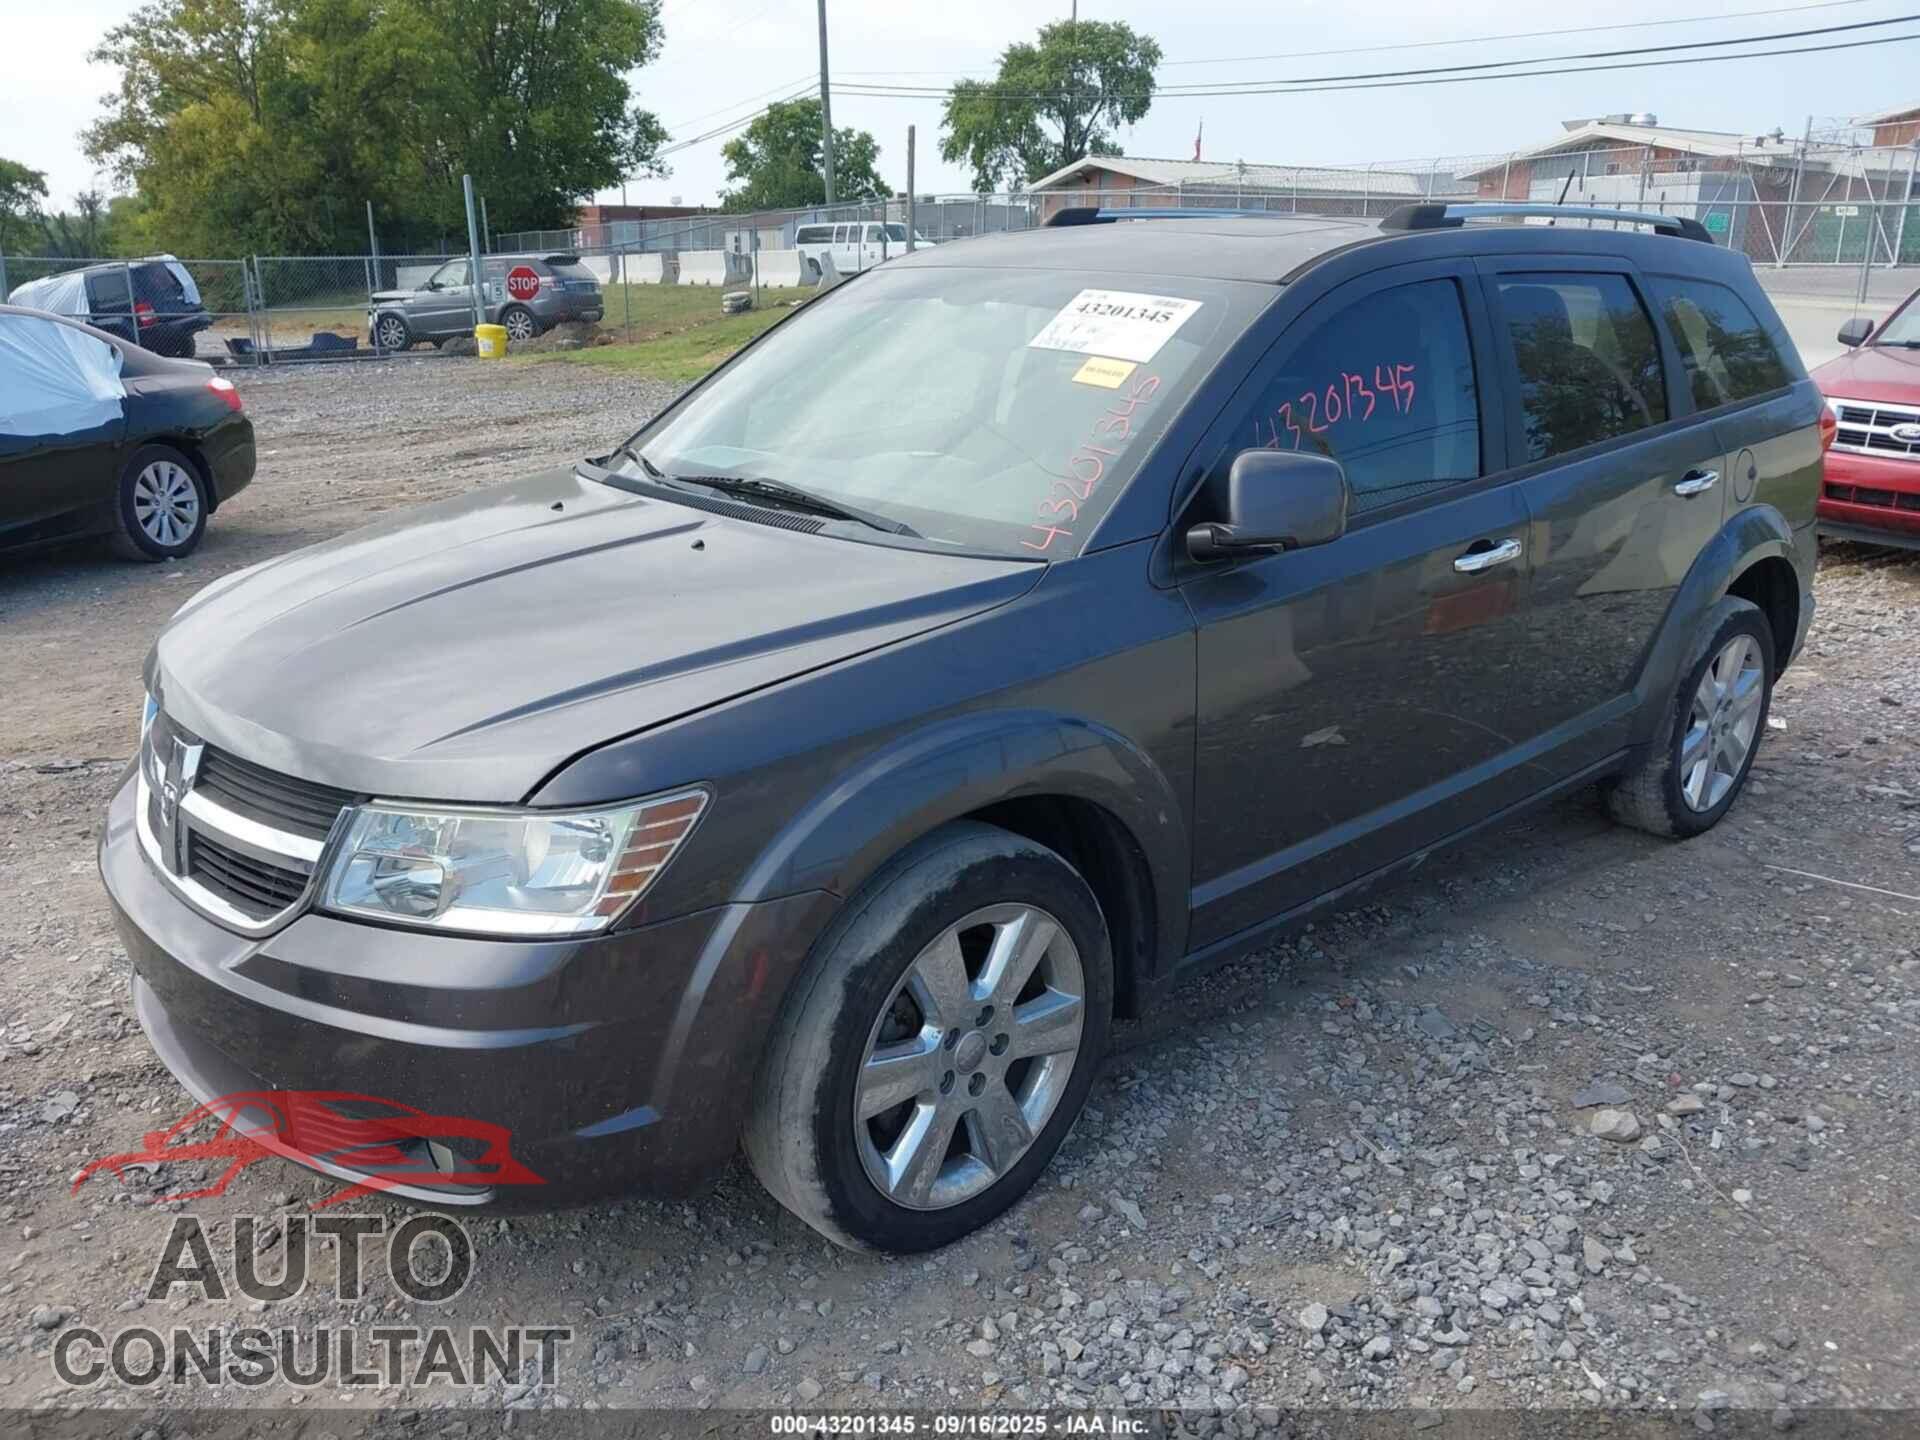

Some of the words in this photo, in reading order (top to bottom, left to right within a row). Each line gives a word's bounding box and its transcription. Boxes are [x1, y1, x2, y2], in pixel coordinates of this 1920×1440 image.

[510, 277, 538, 290] STOP
[1077, 302, 1174, 323] 43201345
[1254, 363, 1416, 449] 43201345
[1019, 373, 1161, 551] 43201345
